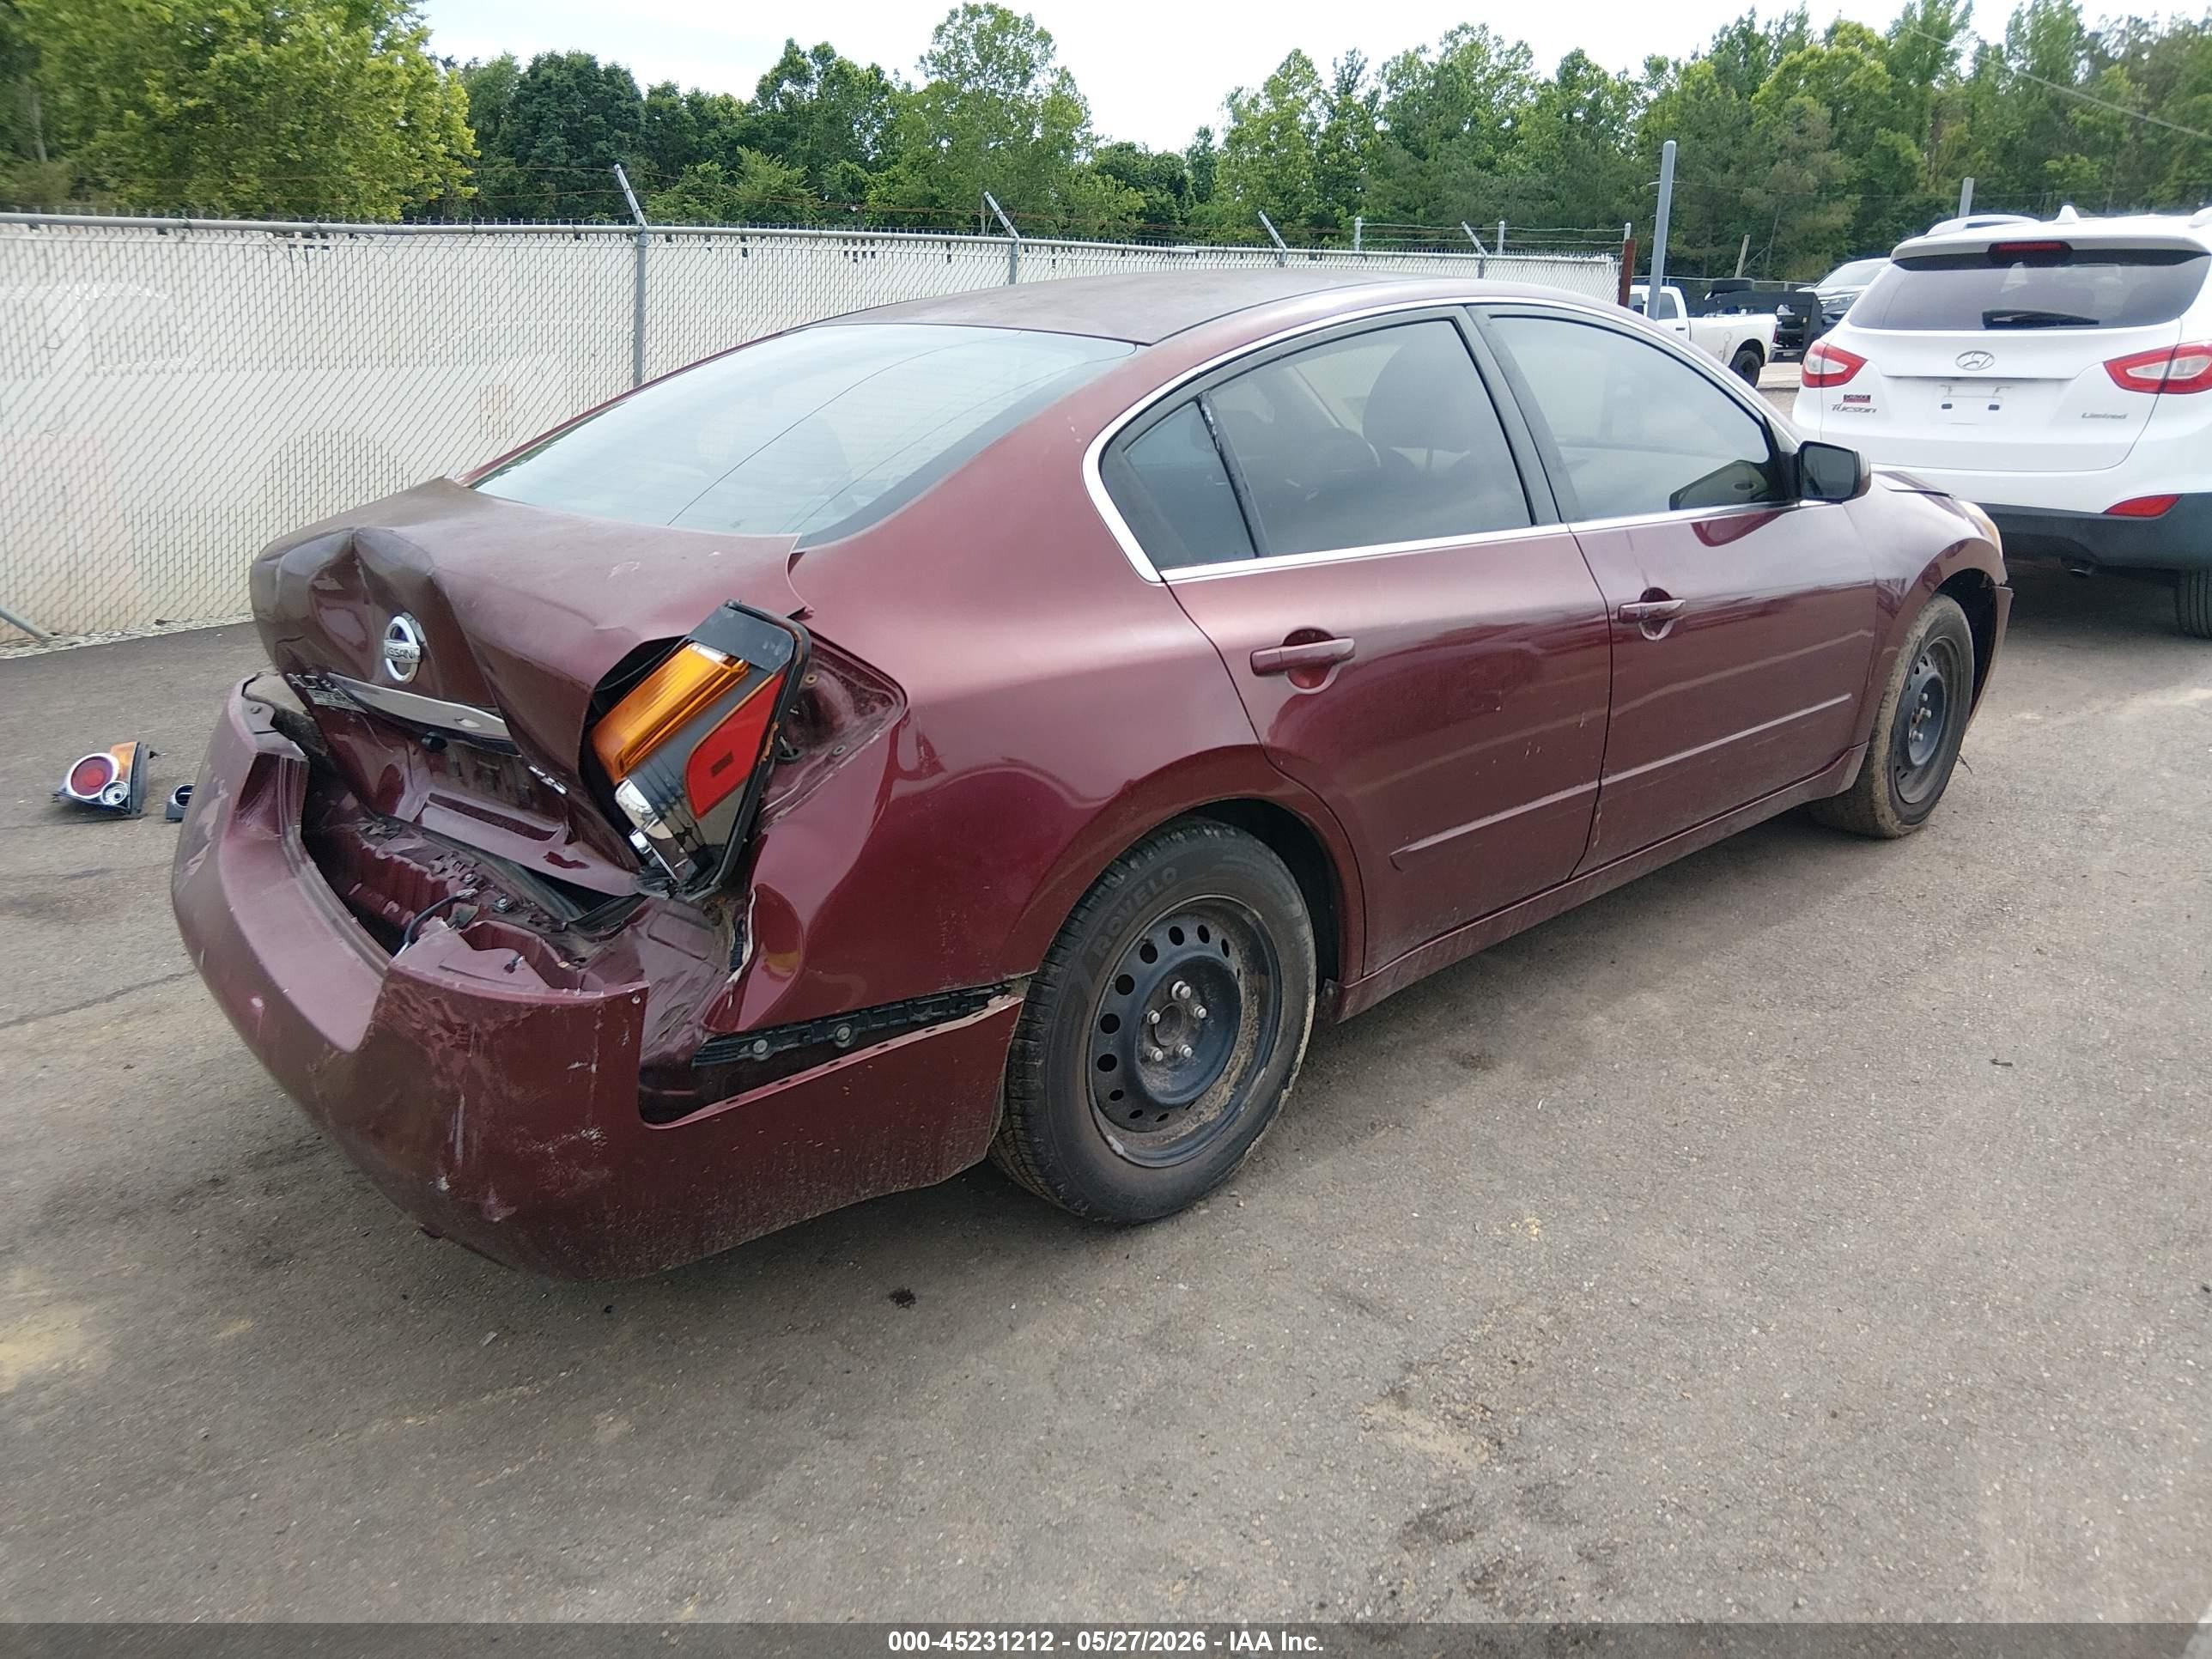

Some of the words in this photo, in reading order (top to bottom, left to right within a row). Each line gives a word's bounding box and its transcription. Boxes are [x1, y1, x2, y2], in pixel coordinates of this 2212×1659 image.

[1831, 404, 1877, 413] Tucson
[386, 646, 414, 661] ISSAN
[1092, 866, 1178, 960] ROVELO
